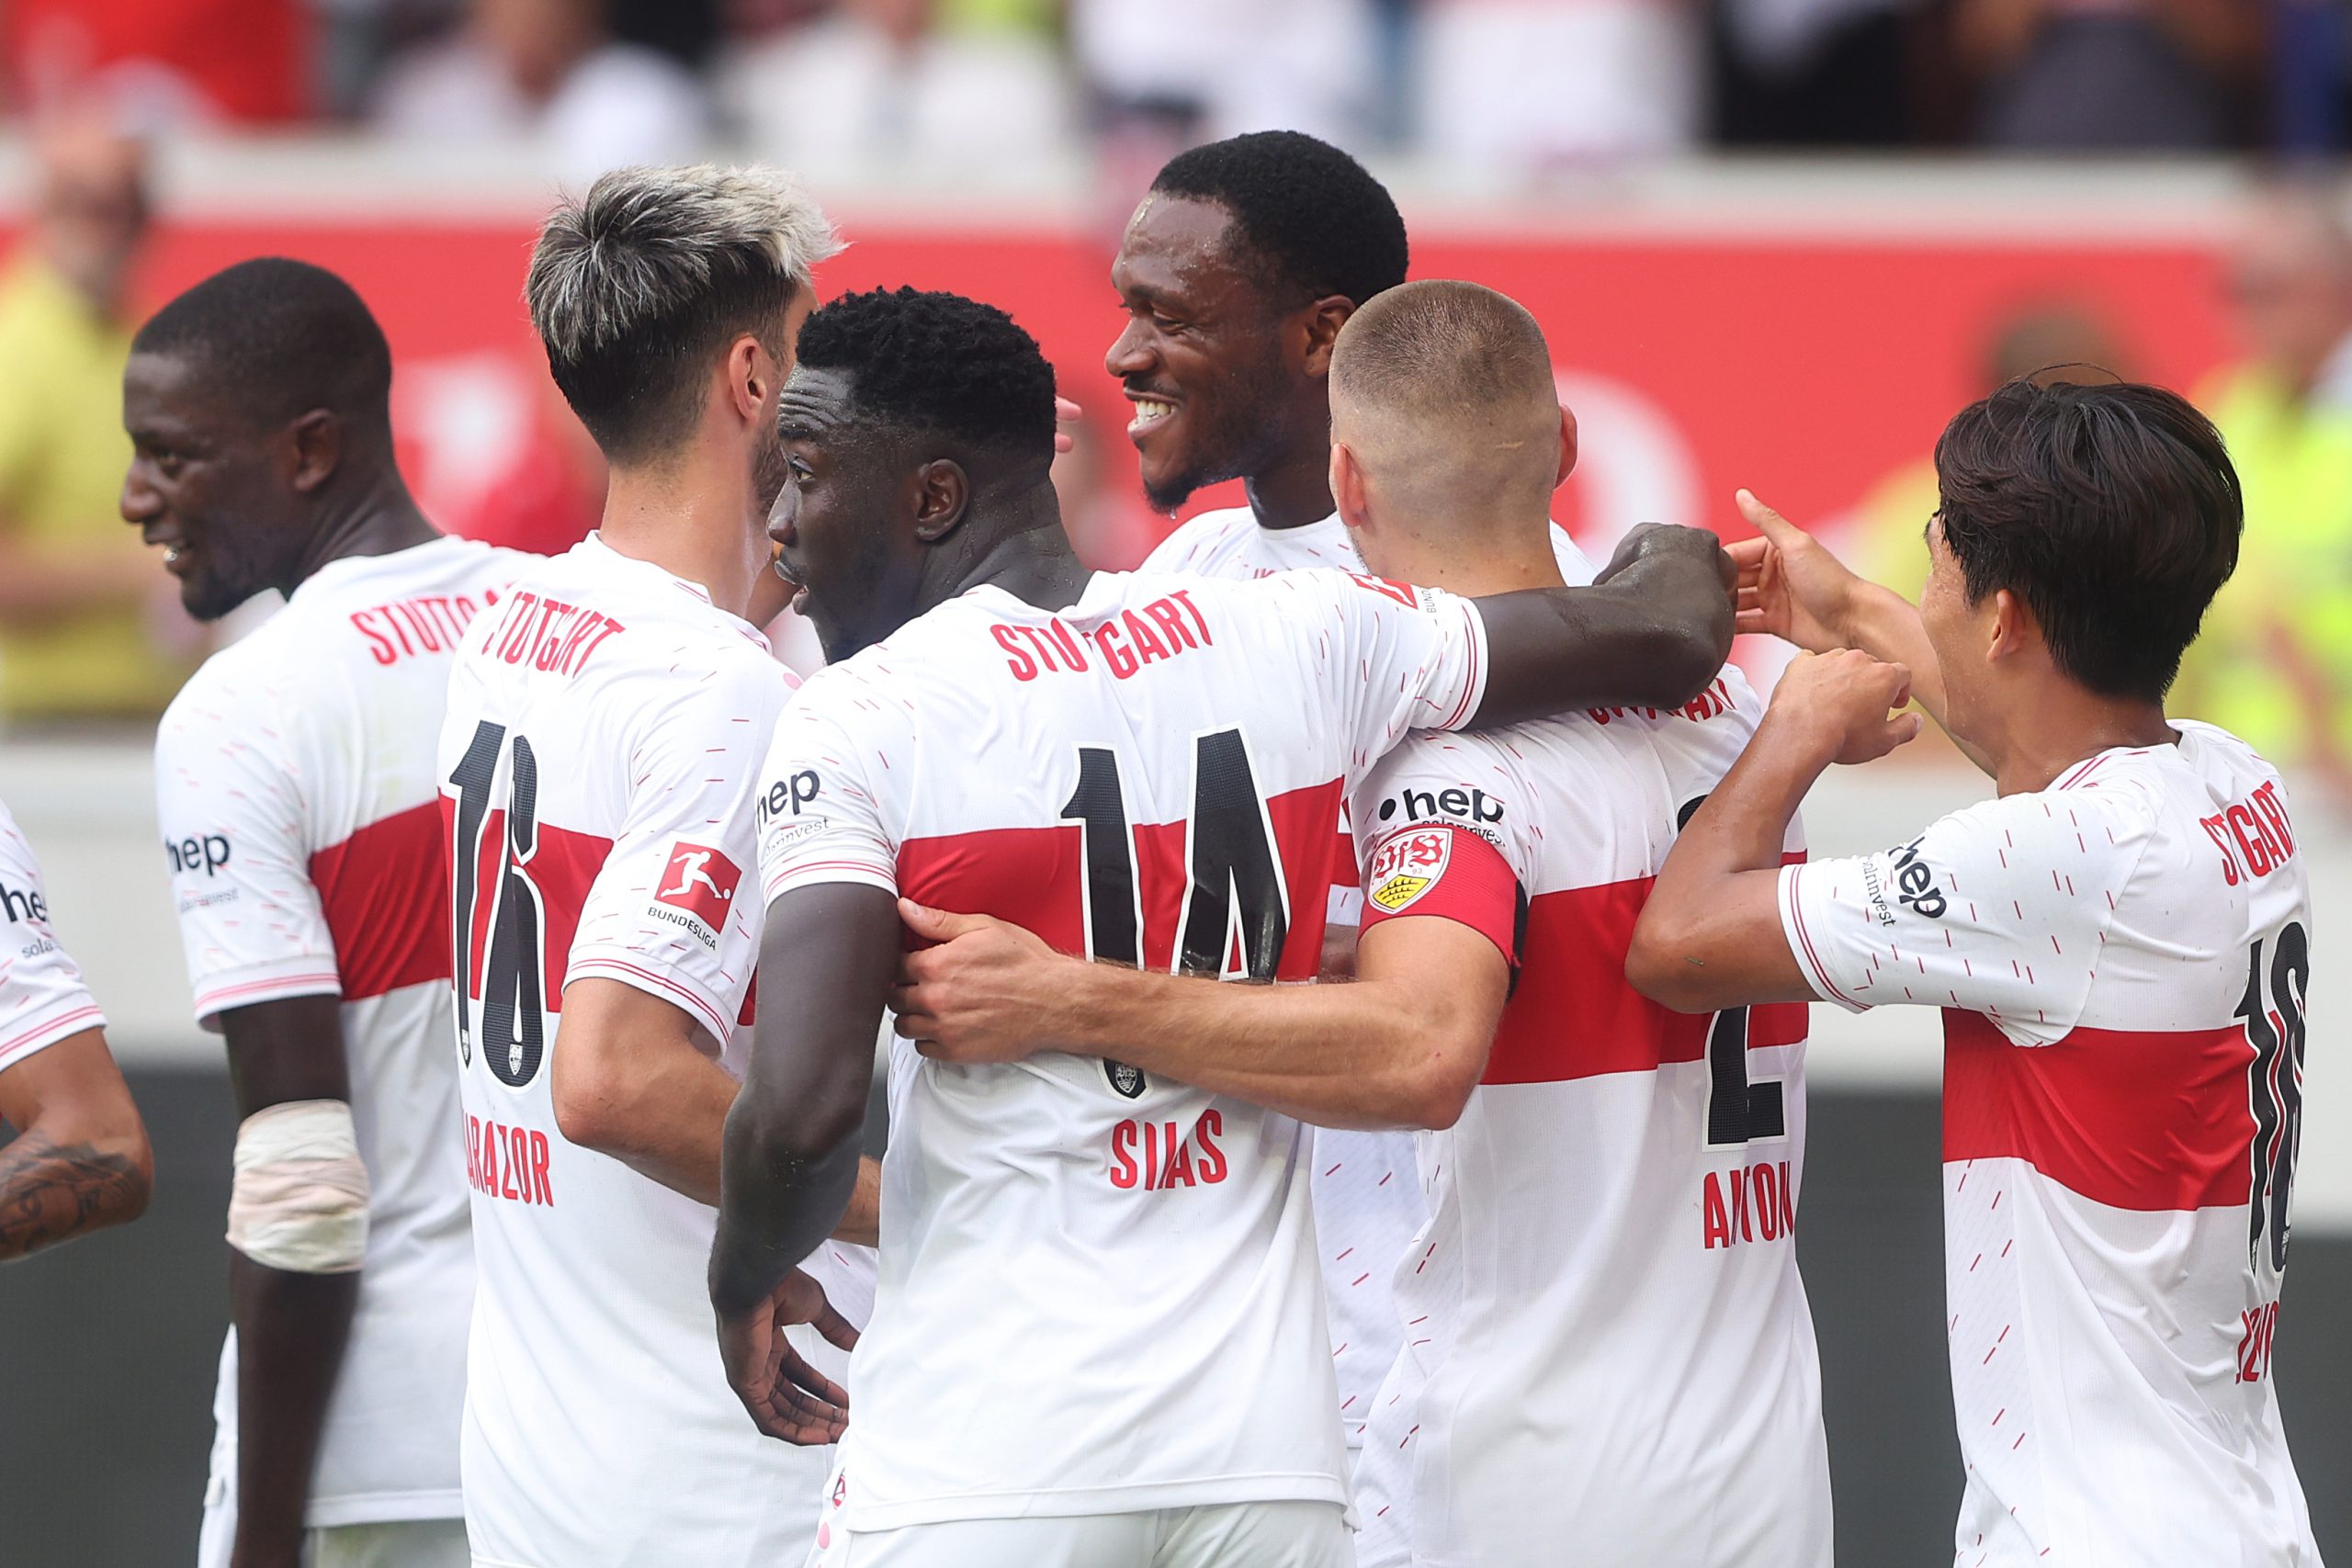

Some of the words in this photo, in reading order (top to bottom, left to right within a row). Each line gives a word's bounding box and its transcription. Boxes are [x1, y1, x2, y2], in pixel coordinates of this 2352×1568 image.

[989, 589, 1213, 682] STUGART
[0, 882, 49, 924] he
[648, 907, 717, 952] BUNDESLIGA
